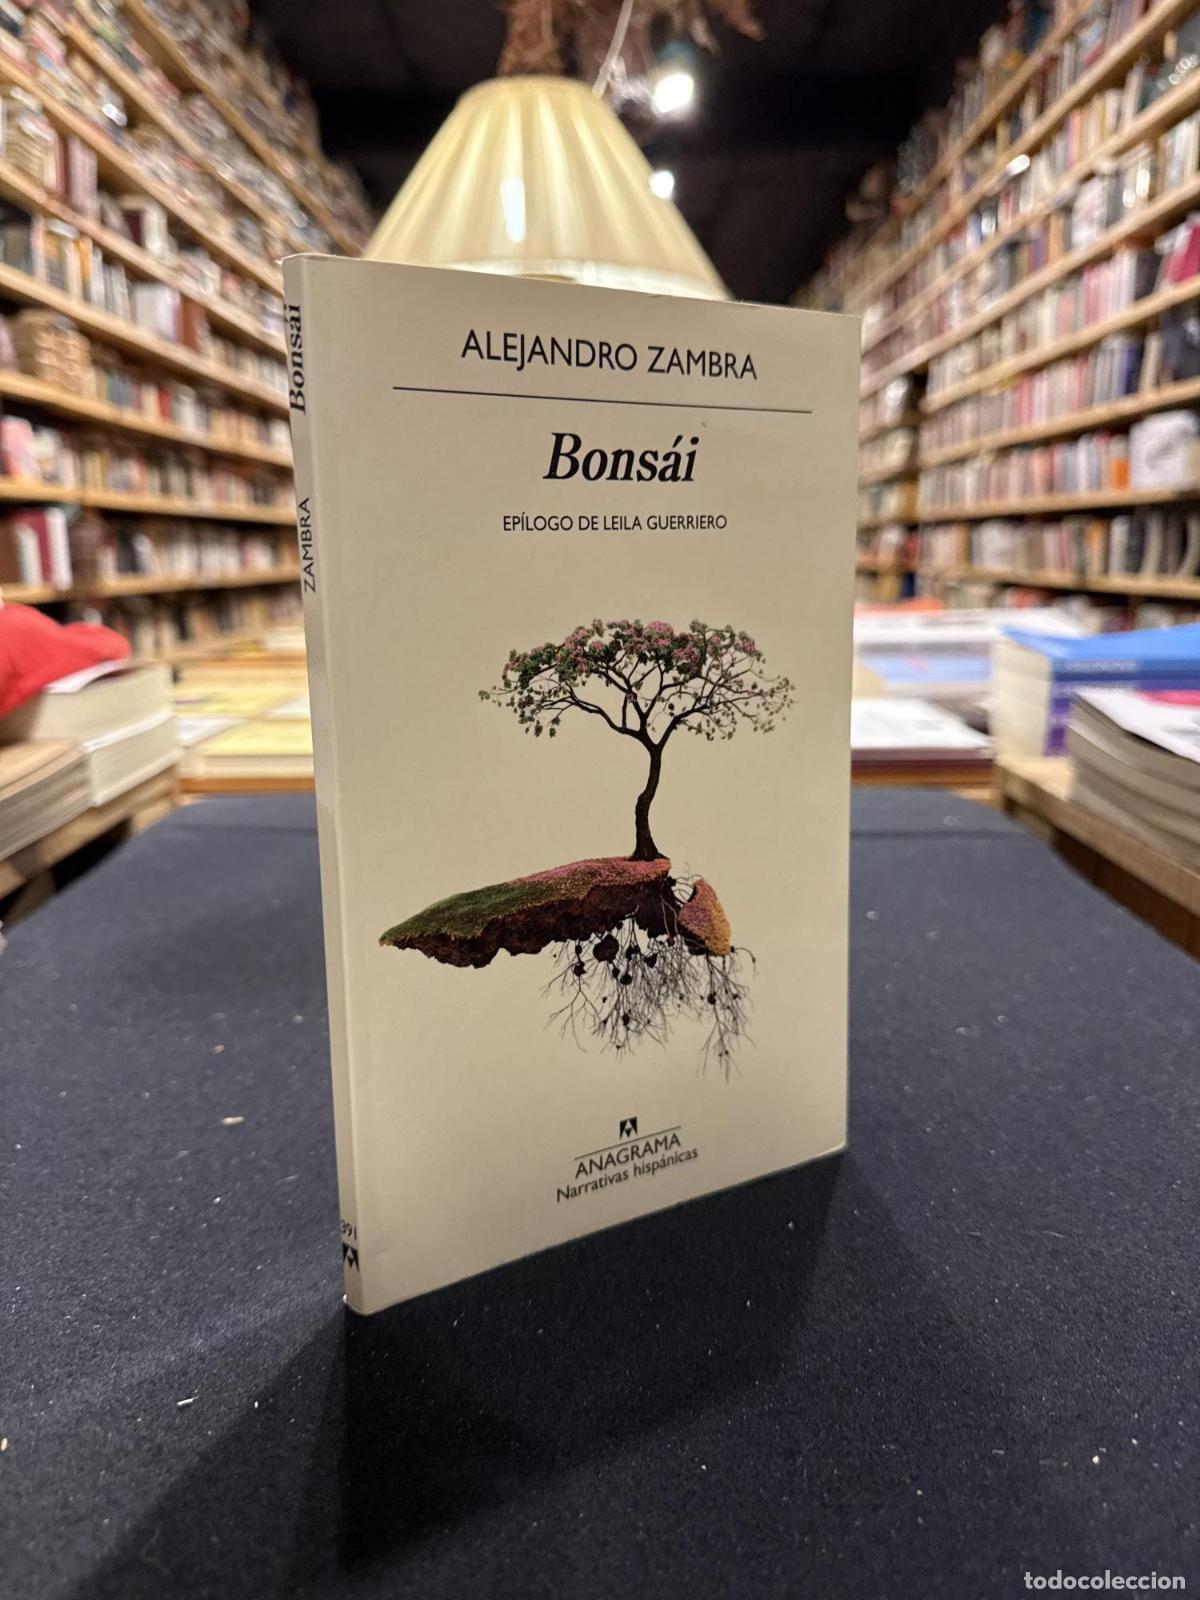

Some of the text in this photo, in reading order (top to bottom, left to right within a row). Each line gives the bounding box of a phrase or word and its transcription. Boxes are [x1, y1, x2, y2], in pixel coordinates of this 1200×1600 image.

[283, 303, 306, 415] Bonsái
[461, 329, 758, 380] ALEJANDRO ZAMBRA
[543, 432, 700, 483] Bonsái
[298, 497, 316, 593] ZAMBRA
[503, 511, 727, 532] EPÍLOGO DE LEILA GUERRIERO
[556, 1148, 698, 1202] Narrativas hispánicas
[575, 1132, 681, 1179] ANAGRAMA
